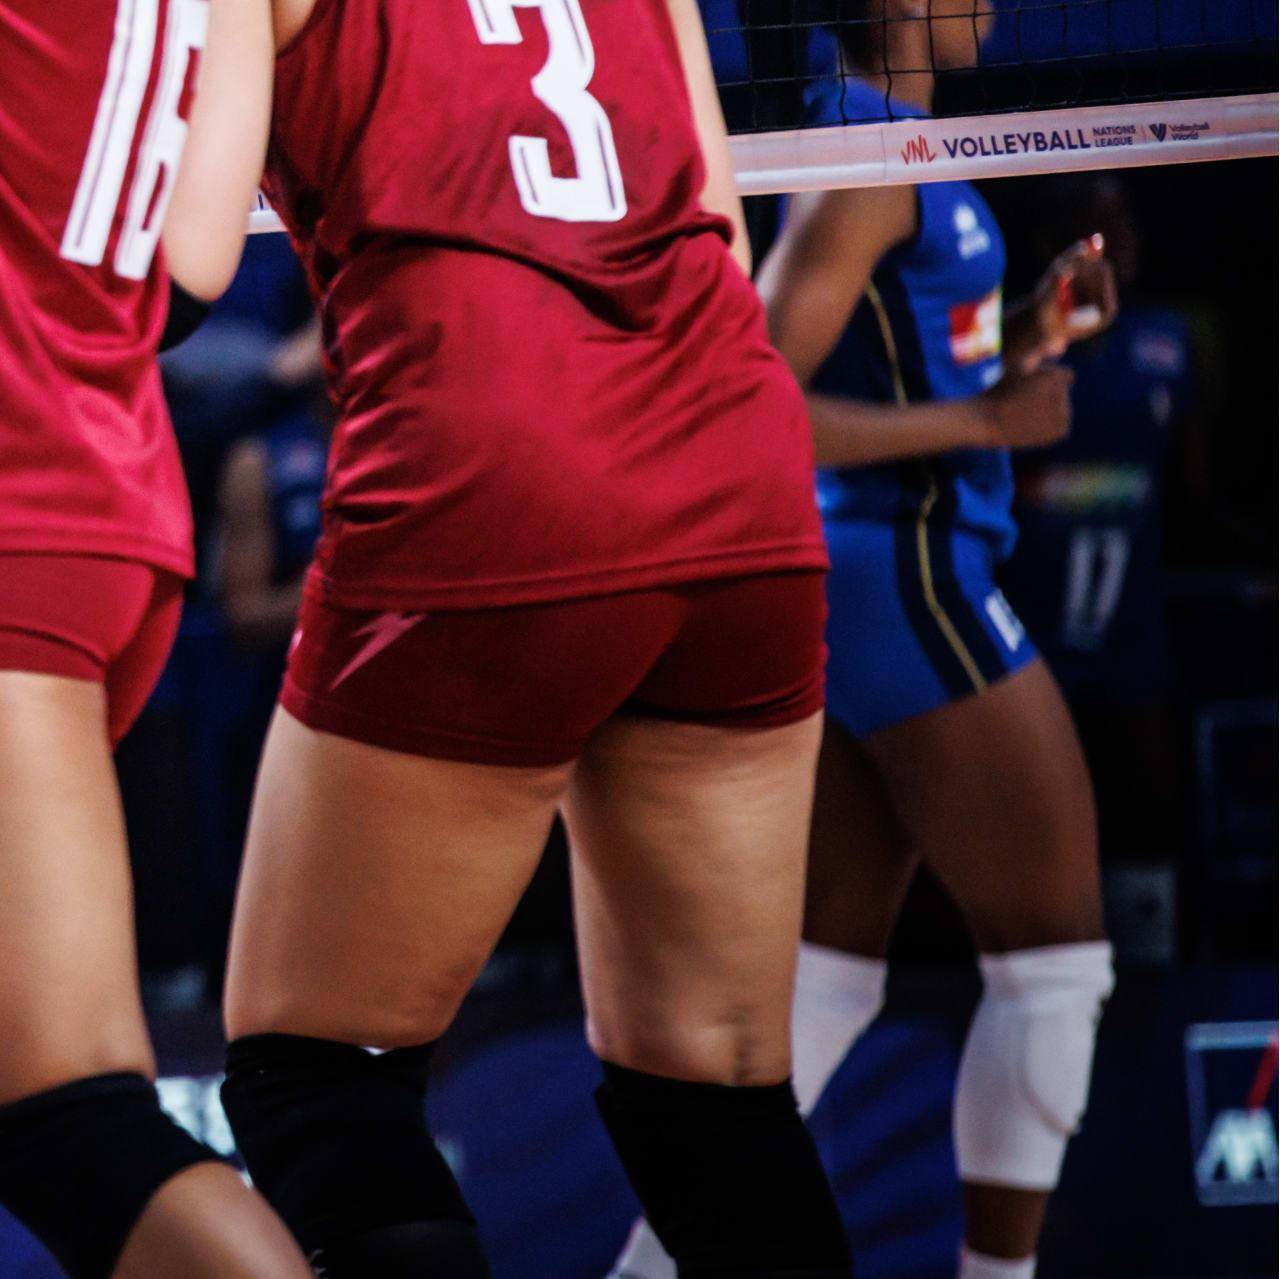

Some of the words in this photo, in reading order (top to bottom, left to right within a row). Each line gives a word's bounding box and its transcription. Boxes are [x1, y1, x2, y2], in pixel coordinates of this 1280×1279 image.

[1092, 124, 1137, 136] NATIONS
[942, 128, 1092, 159] VOLLEYBALL
[1095, 136, 1134, 148] LEAGUE
